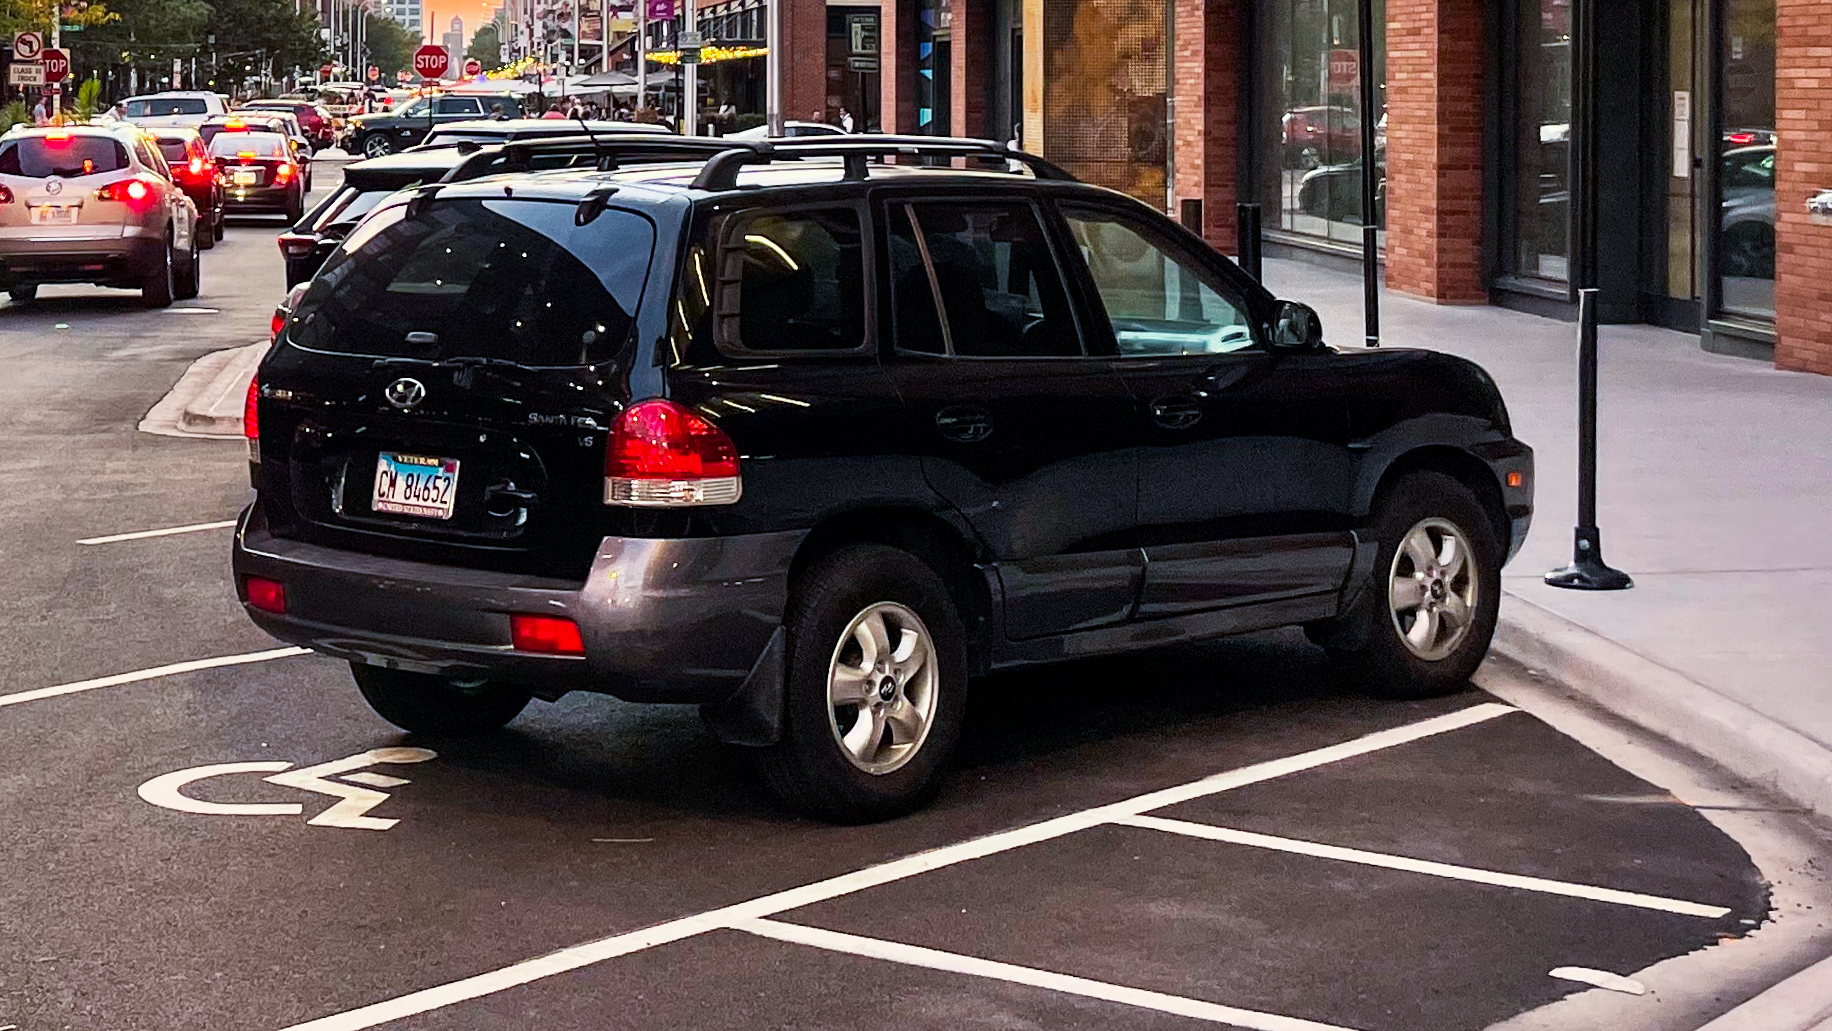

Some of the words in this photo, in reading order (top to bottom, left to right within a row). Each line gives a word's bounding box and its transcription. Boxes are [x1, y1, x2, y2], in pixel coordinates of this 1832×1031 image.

[416, 54, 447, 69] STOP
[377, 470, 398, 500] CM
[403, 473, 451, 504] 84652
